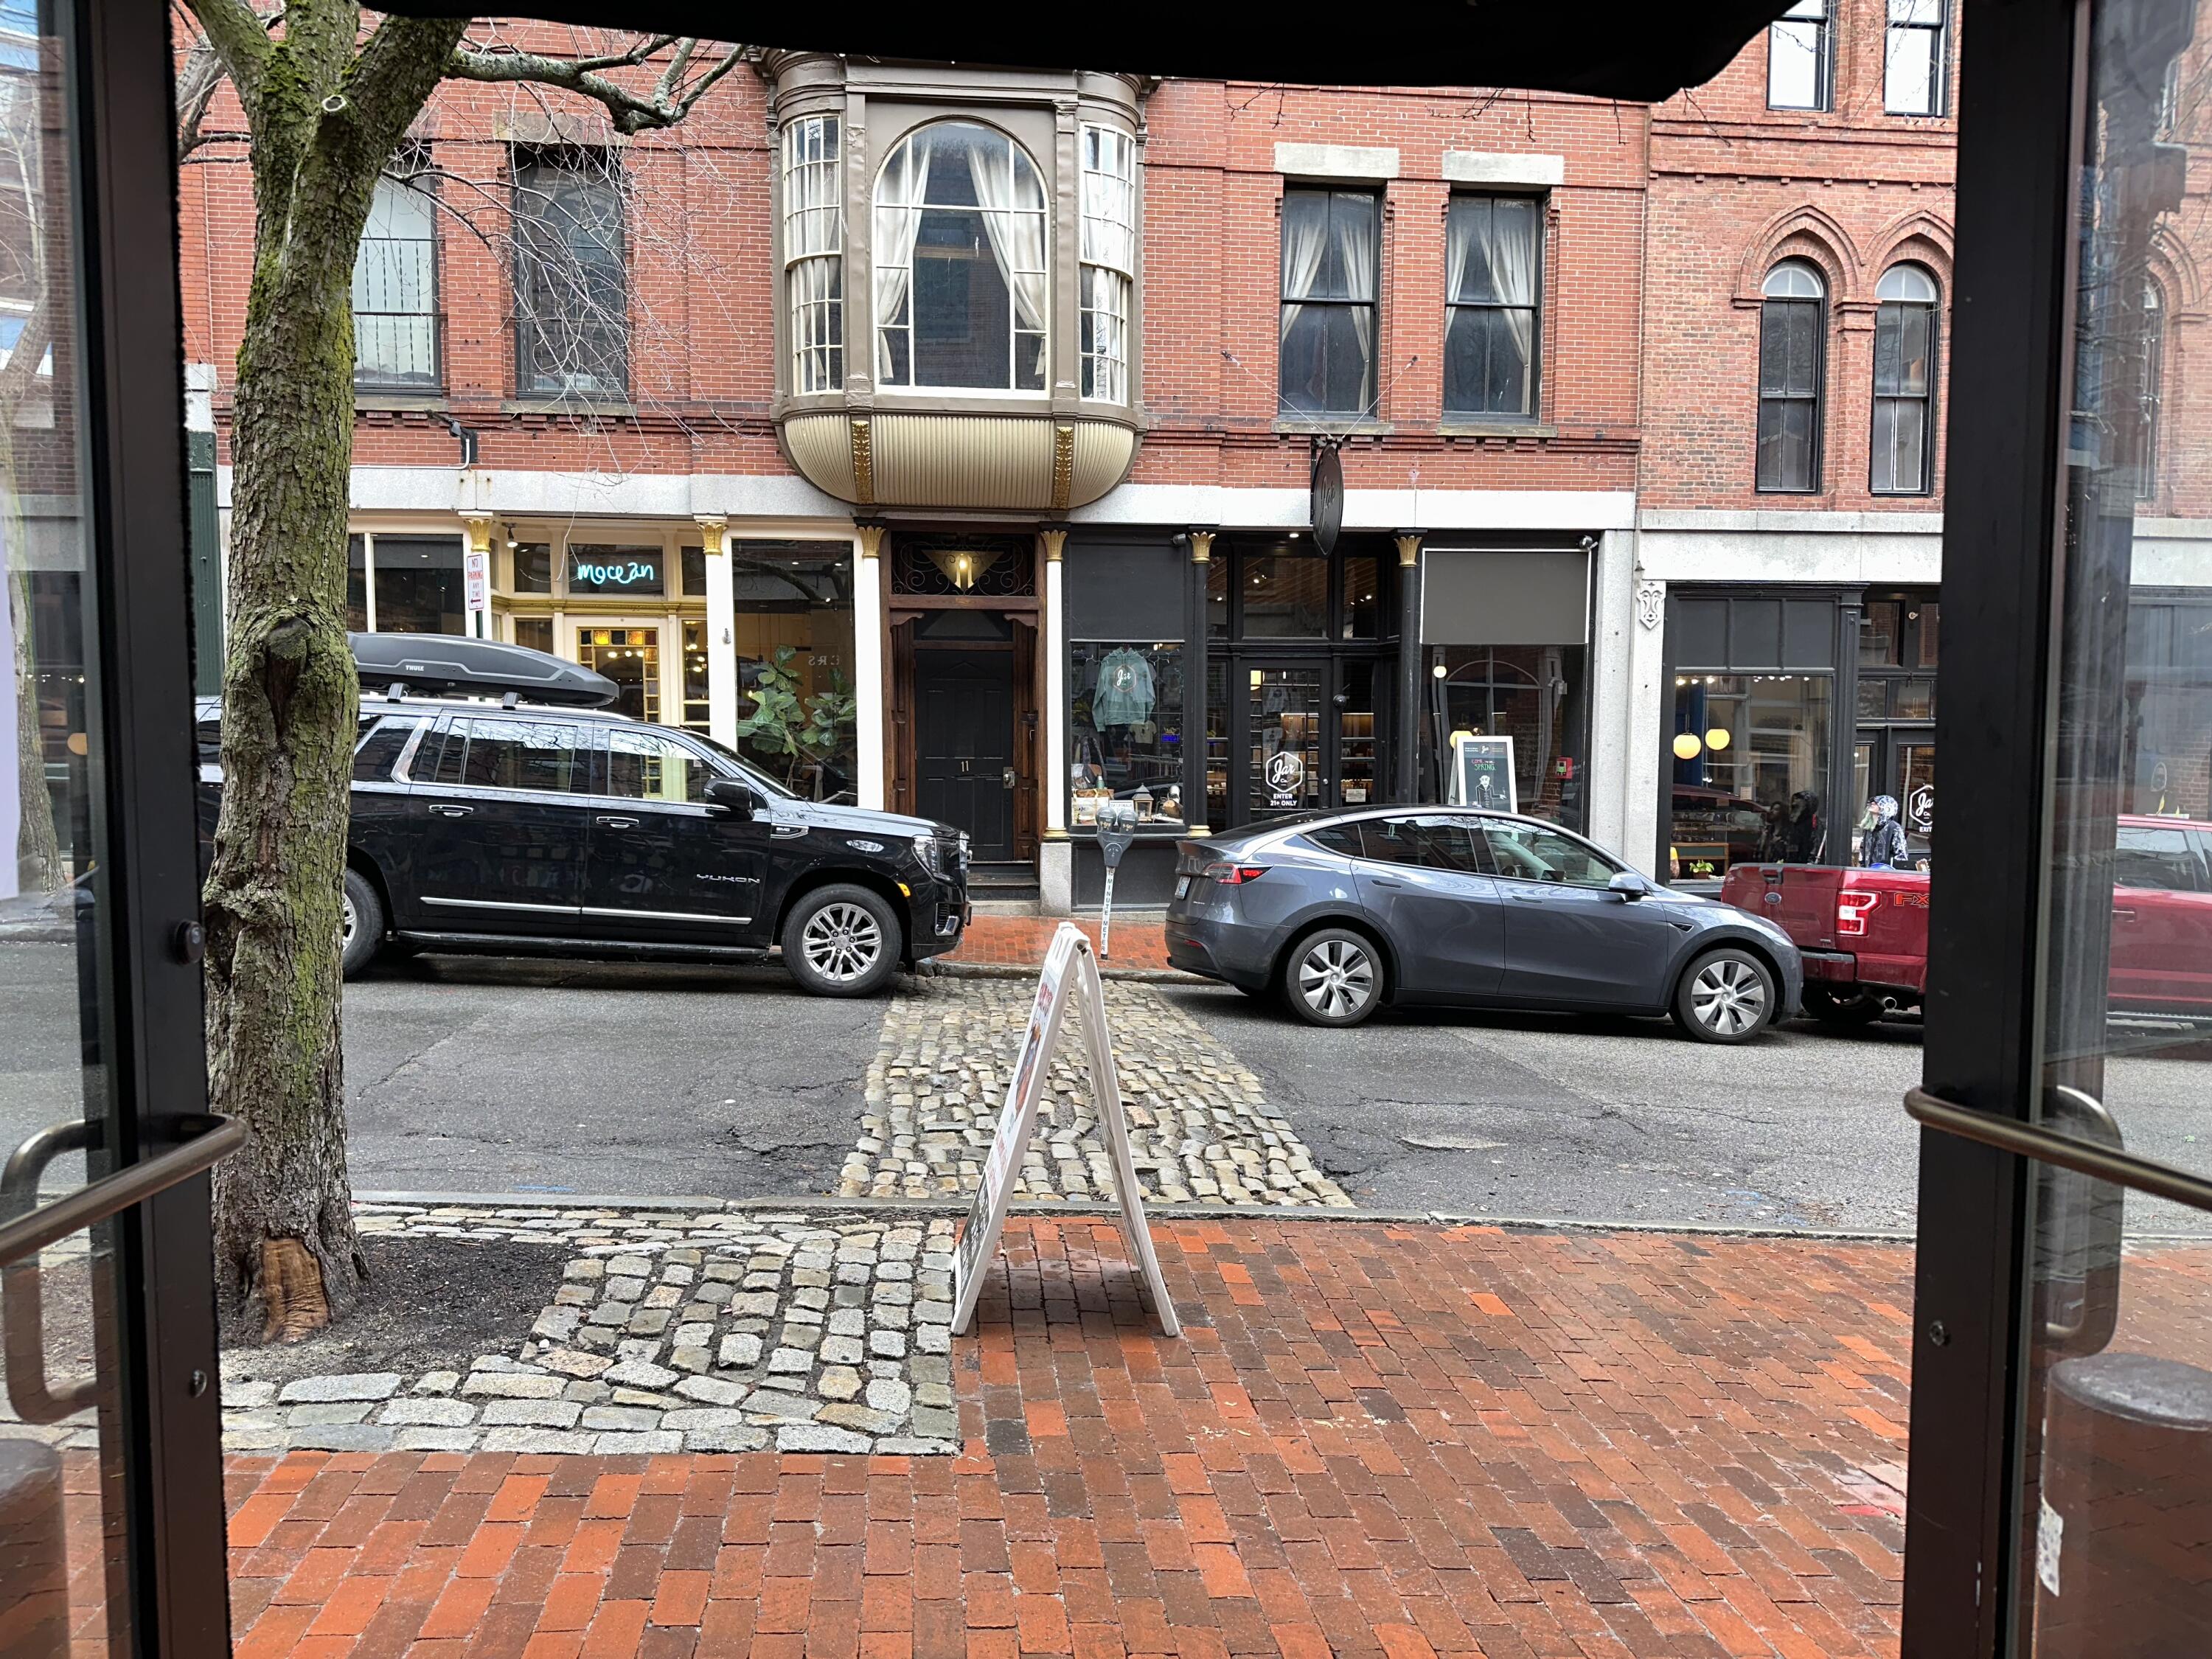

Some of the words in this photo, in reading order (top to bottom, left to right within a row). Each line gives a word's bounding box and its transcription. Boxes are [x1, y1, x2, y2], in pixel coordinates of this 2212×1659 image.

[472, 558, 479, 568] NO
[467, 570, 484, 582] PARKING
[961, 760, 969, 772] 11
[1272, 759, 1295, 784] Jar
[1916, 792, 1934, 817] Ja
[696, 874, 760, 884] YUKON
[1105, 878, 1113, 916] MINUTE
[1893, 892, 1930, 907] FX
